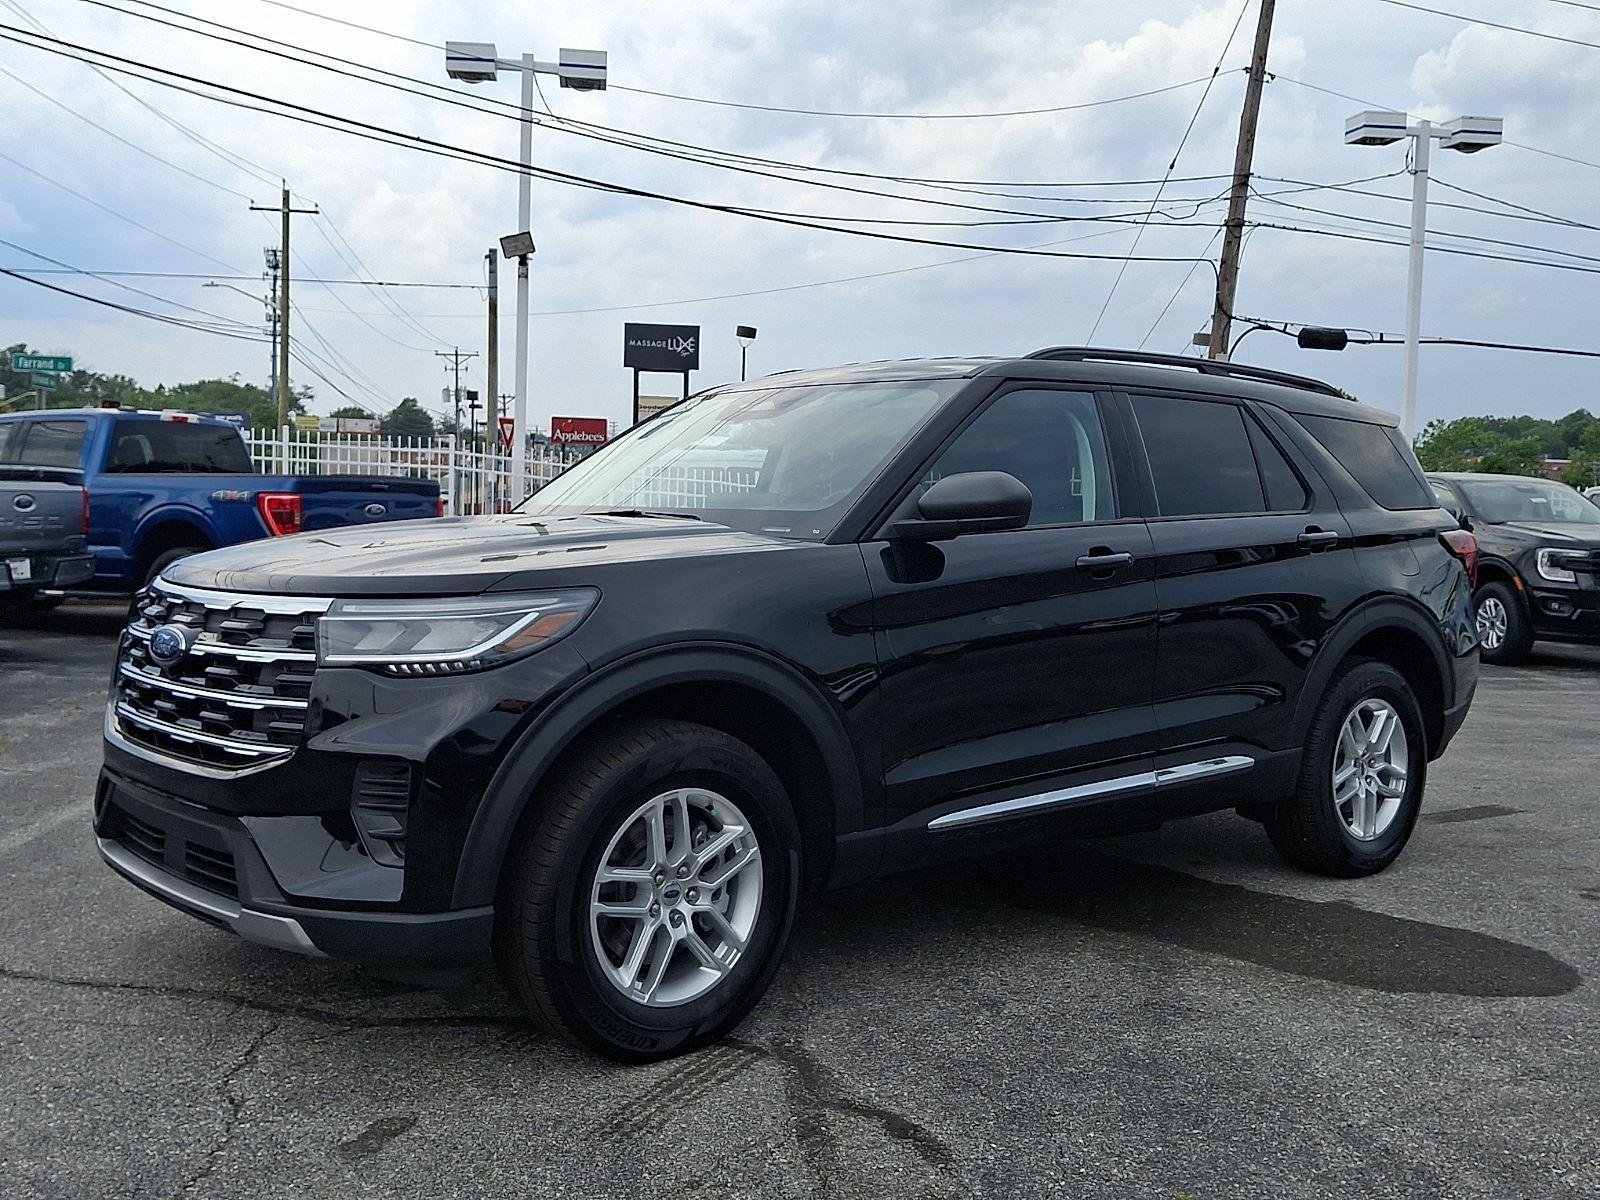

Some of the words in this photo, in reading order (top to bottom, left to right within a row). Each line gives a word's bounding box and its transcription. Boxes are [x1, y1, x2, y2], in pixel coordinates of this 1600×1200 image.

[629, 339, 667, 348] MASSAGE
[667, 335, 695, 353] LUXE
[19, 357, 54, 369] Farrand
[553, 428, 605, 442] Applebee's
